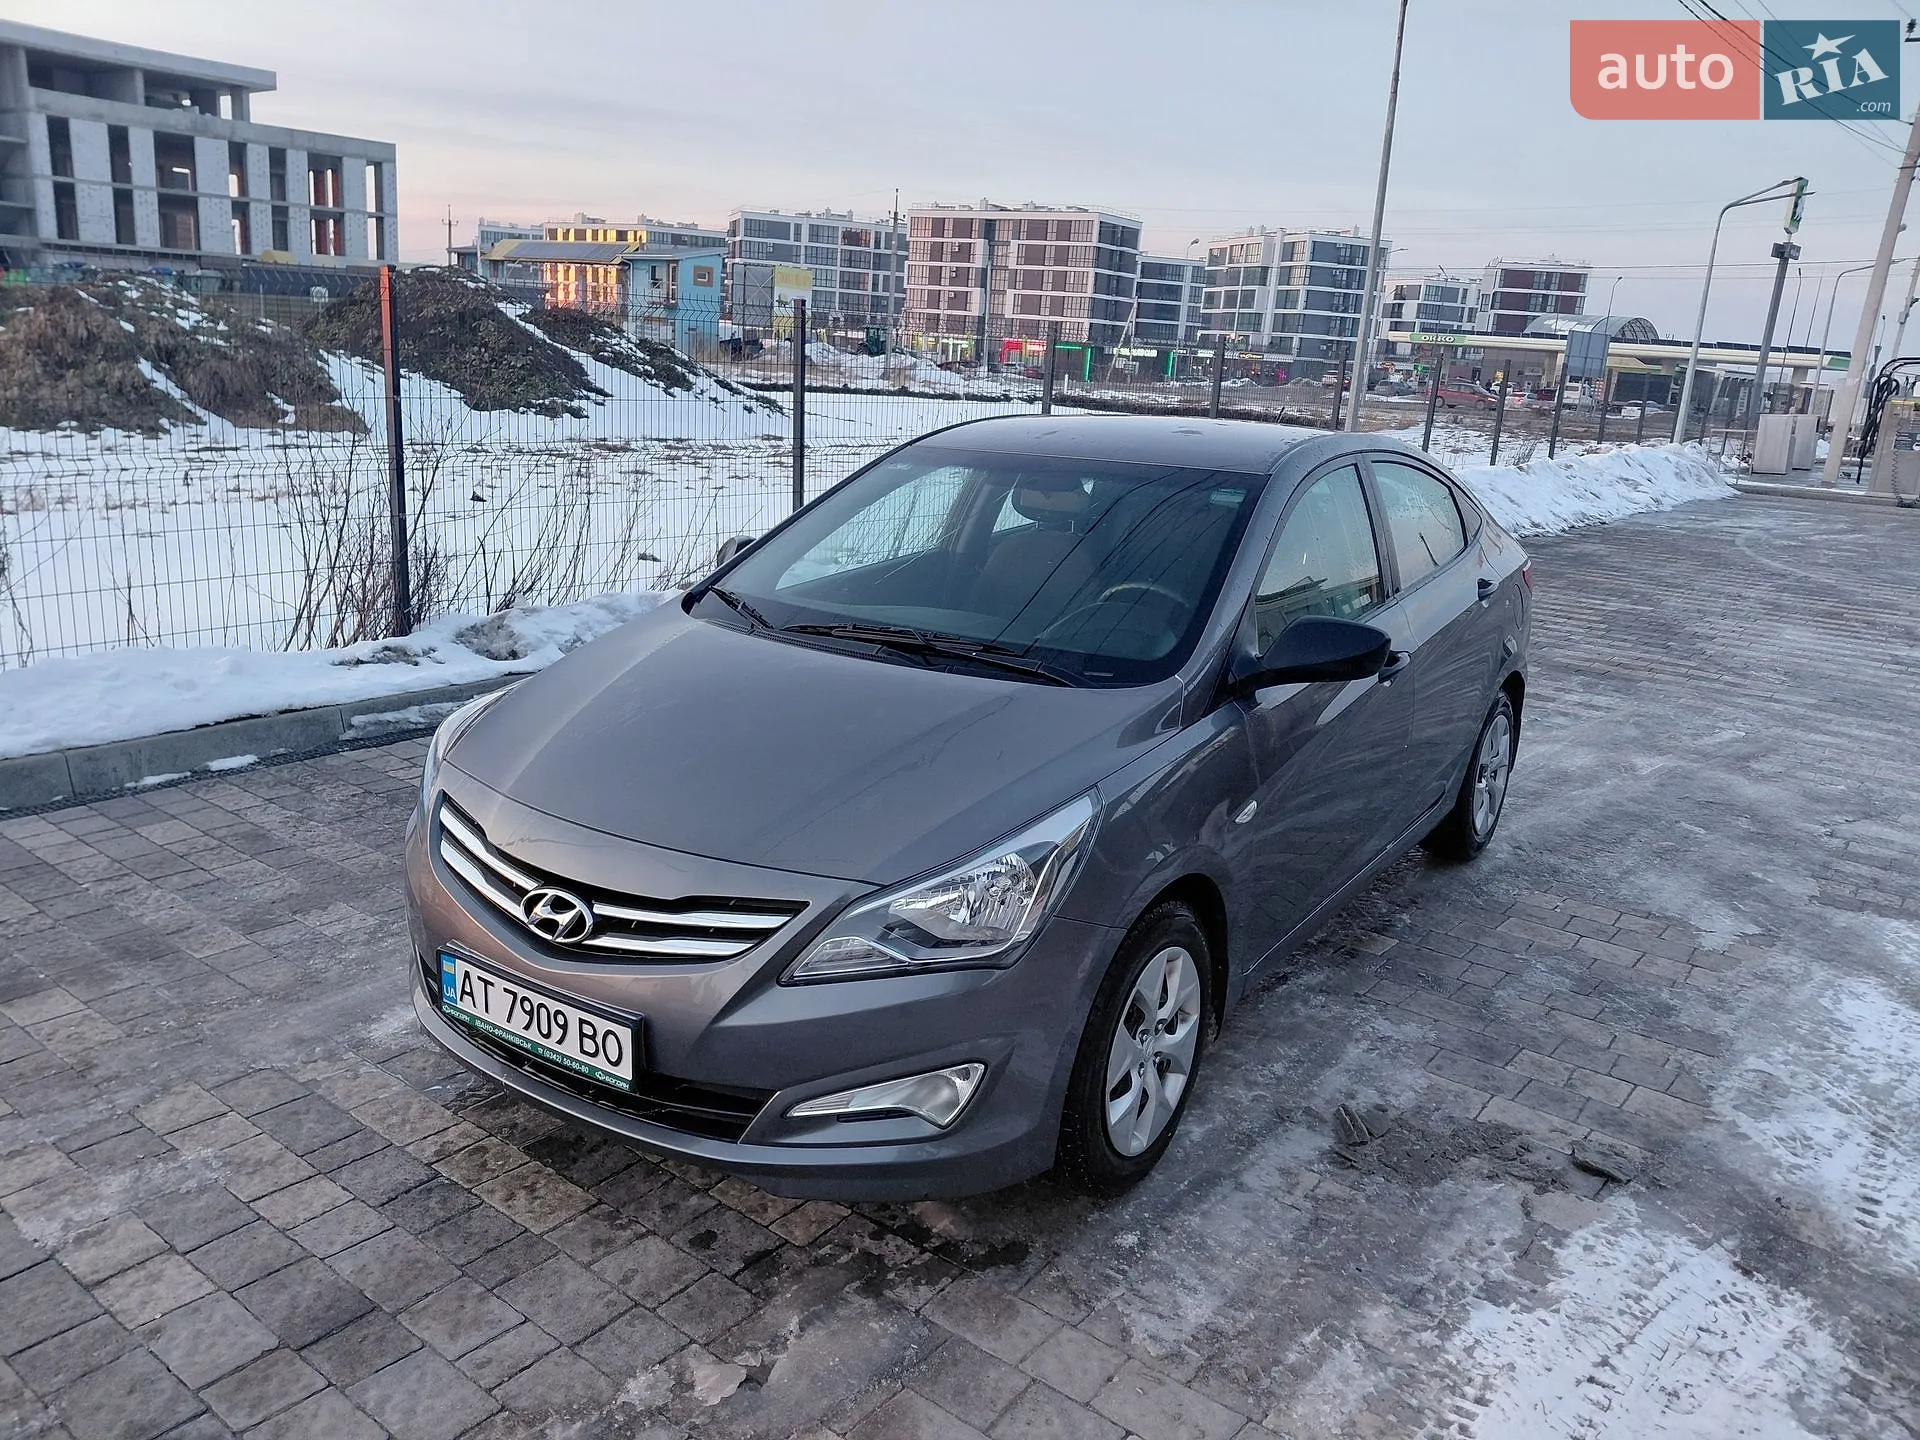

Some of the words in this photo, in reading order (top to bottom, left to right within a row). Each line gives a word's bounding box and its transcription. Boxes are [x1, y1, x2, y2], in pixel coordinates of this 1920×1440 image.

[443, 984, 457, 1000] UA
[459, 970, 495, 1014] AT
[502, 988, 569, 1046] 7909
[578, 1017, 624, 1068] BO
